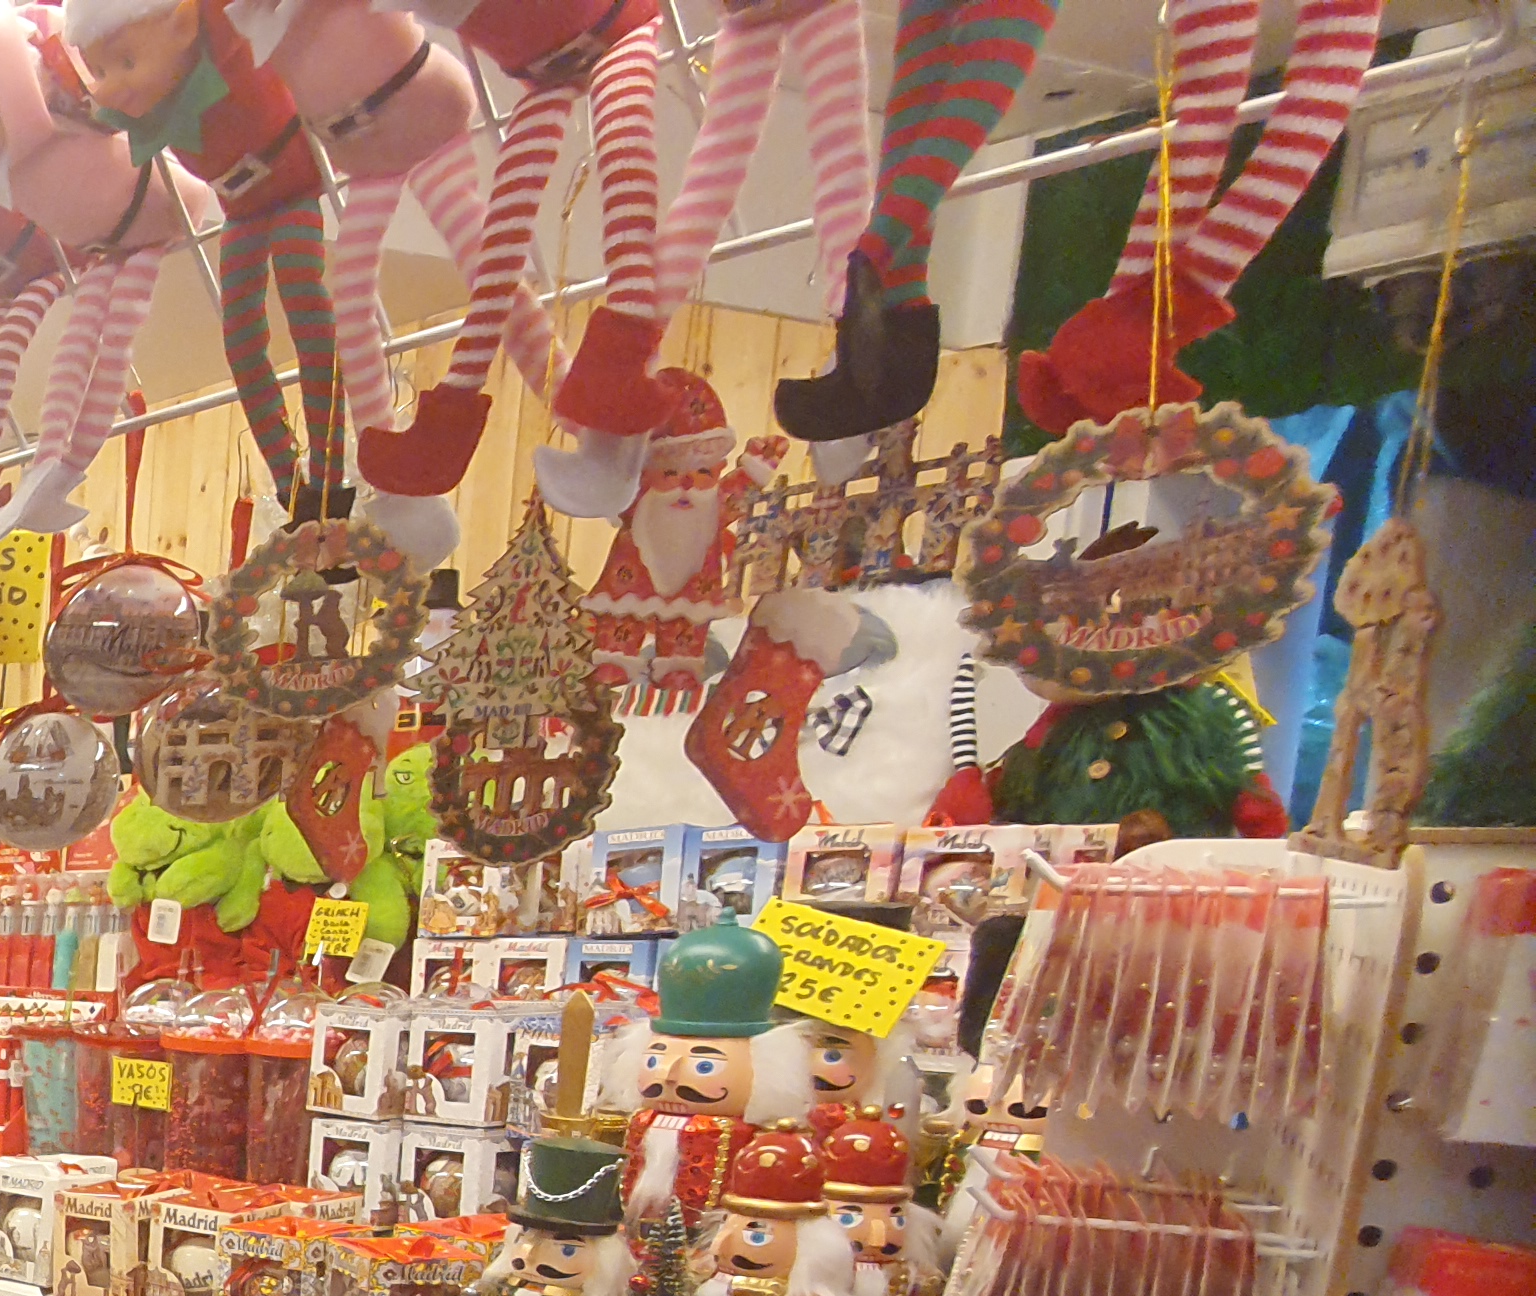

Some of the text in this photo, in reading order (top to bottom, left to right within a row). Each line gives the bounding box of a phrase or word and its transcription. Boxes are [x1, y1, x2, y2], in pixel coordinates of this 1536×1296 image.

[117, 1062, 167, 1083] VASOS
[64, 1195, 113, 1219] Madrid
[316, 1201, 357, 1220] Madrid
[162, 1207, 219, 1232] Madrid
